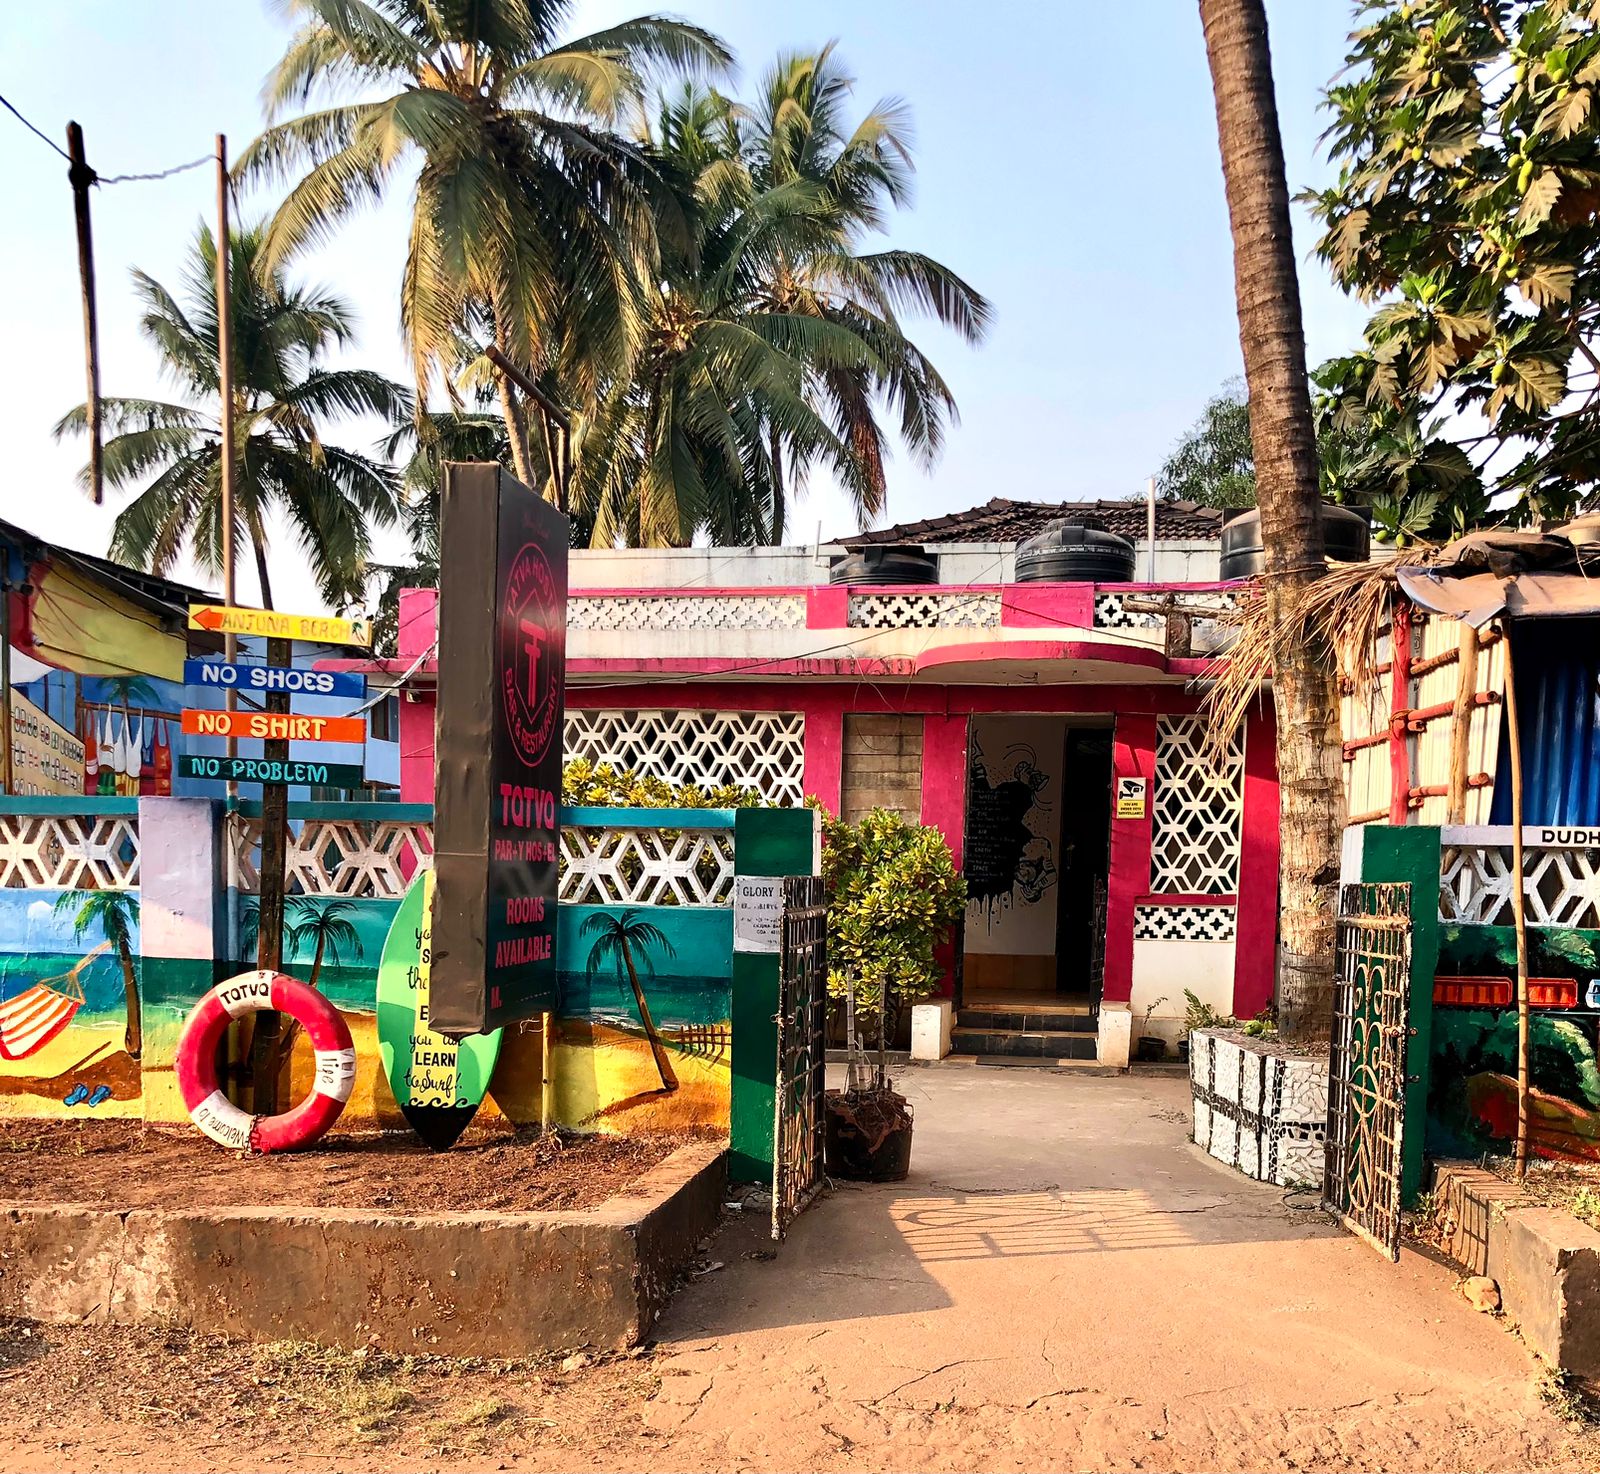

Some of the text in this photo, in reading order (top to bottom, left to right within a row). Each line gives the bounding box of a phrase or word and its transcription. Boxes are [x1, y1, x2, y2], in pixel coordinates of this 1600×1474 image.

[222, 612, 350, 640] ANJUNA BEACH
[202, 664, 335, 693] NO SHOES
[198, 713, 328, 741] NO SHIRT
[191, 757, 328, 783] NO PROBLEM
[1542, 830, 1600, 845] DUDH
[742, 886, 774, 897] GLORY
[506, 896, 545, 925] ROOMS
[415, 927, 432, 949] yo
[495, 935, 552, 968] AVAILABLE
[409, 1034, 432, 1054] you
[415, 1051, 456, 1067] LEARN
